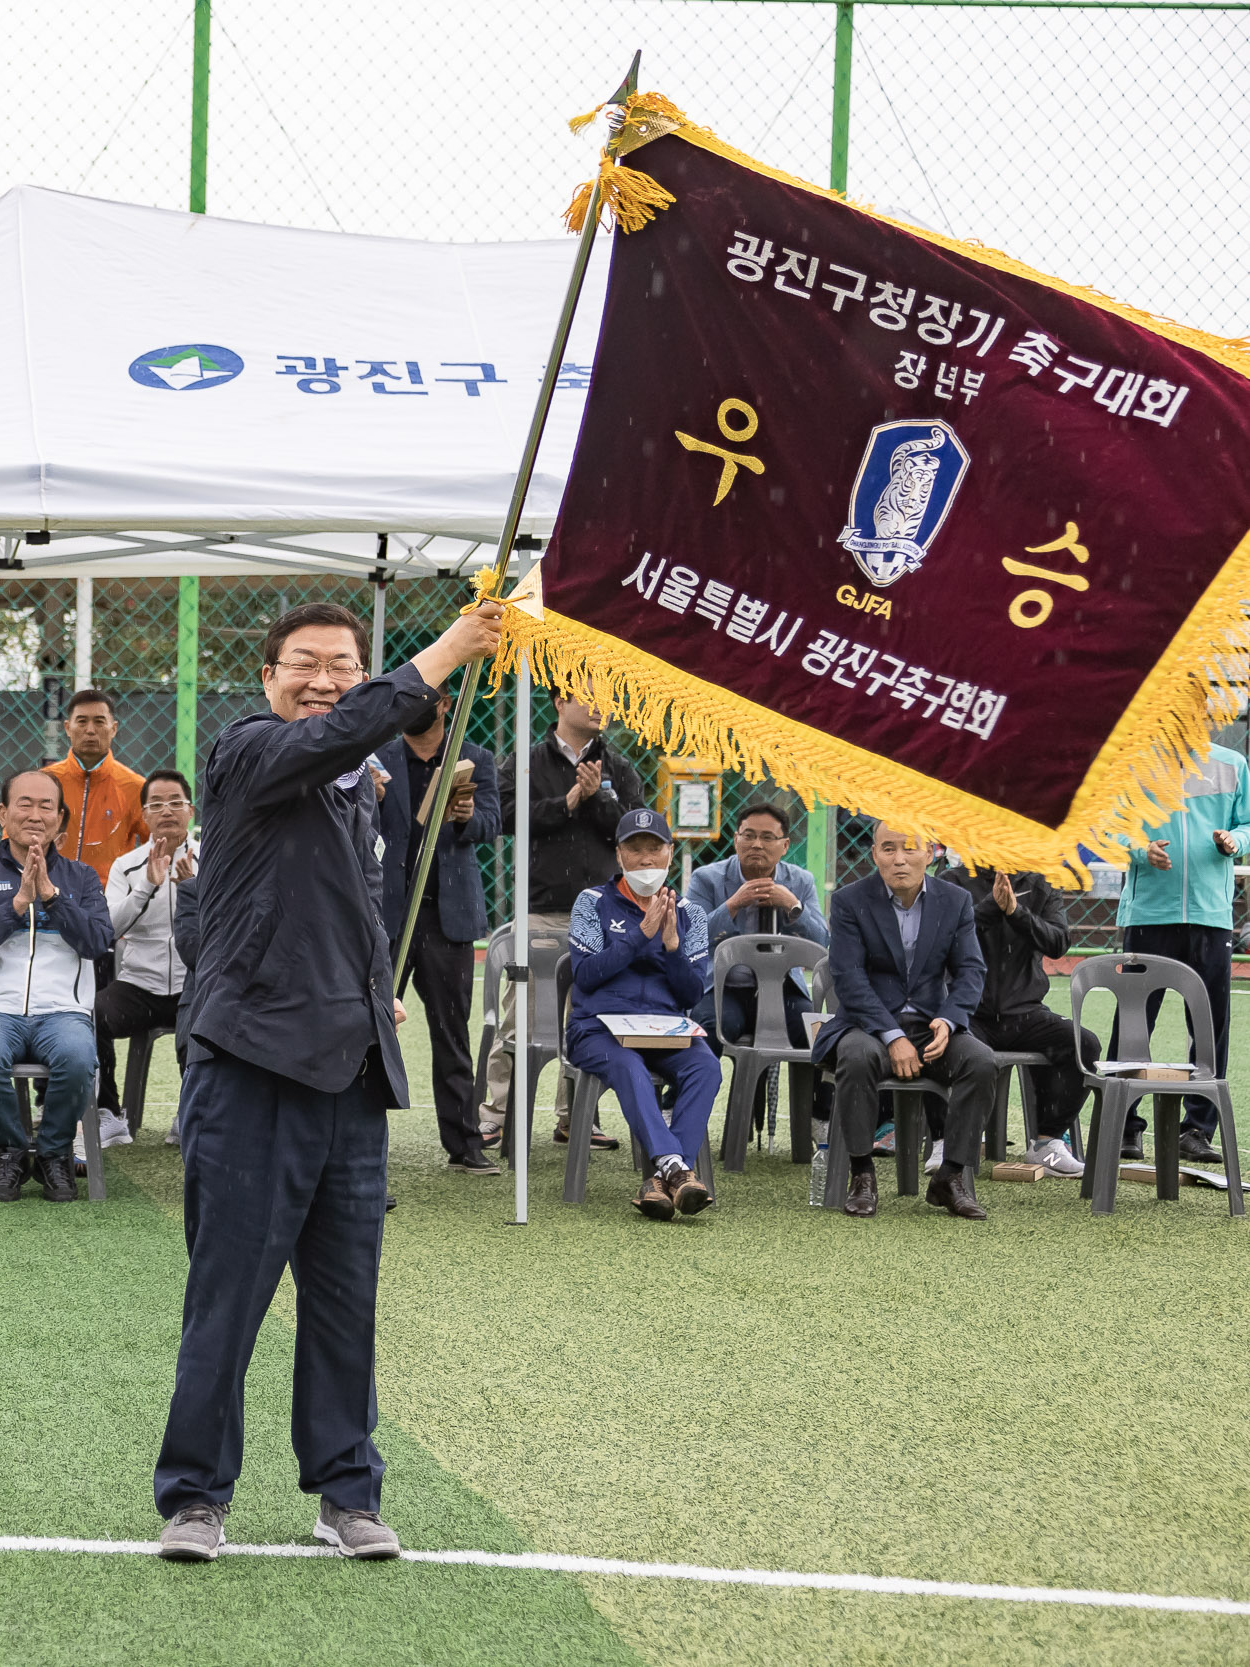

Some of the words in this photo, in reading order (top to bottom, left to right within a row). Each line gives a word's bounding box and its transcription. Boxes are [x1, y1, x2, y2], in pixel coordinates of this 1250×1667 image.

[275, 355, 508, 397] 광진구
[726, 231, 1005, 358] 광진구청장기
[1008, 330, 1190, 428] 축구대회
[675, 398, 765, 507] 우
[1002, 521, 1090, 629] 승
[836, 584, 892, 620] GJFA
[621, 552, 803, 657] 서울특별시
[801, 629, 1007, 741] 광진구축구협회
